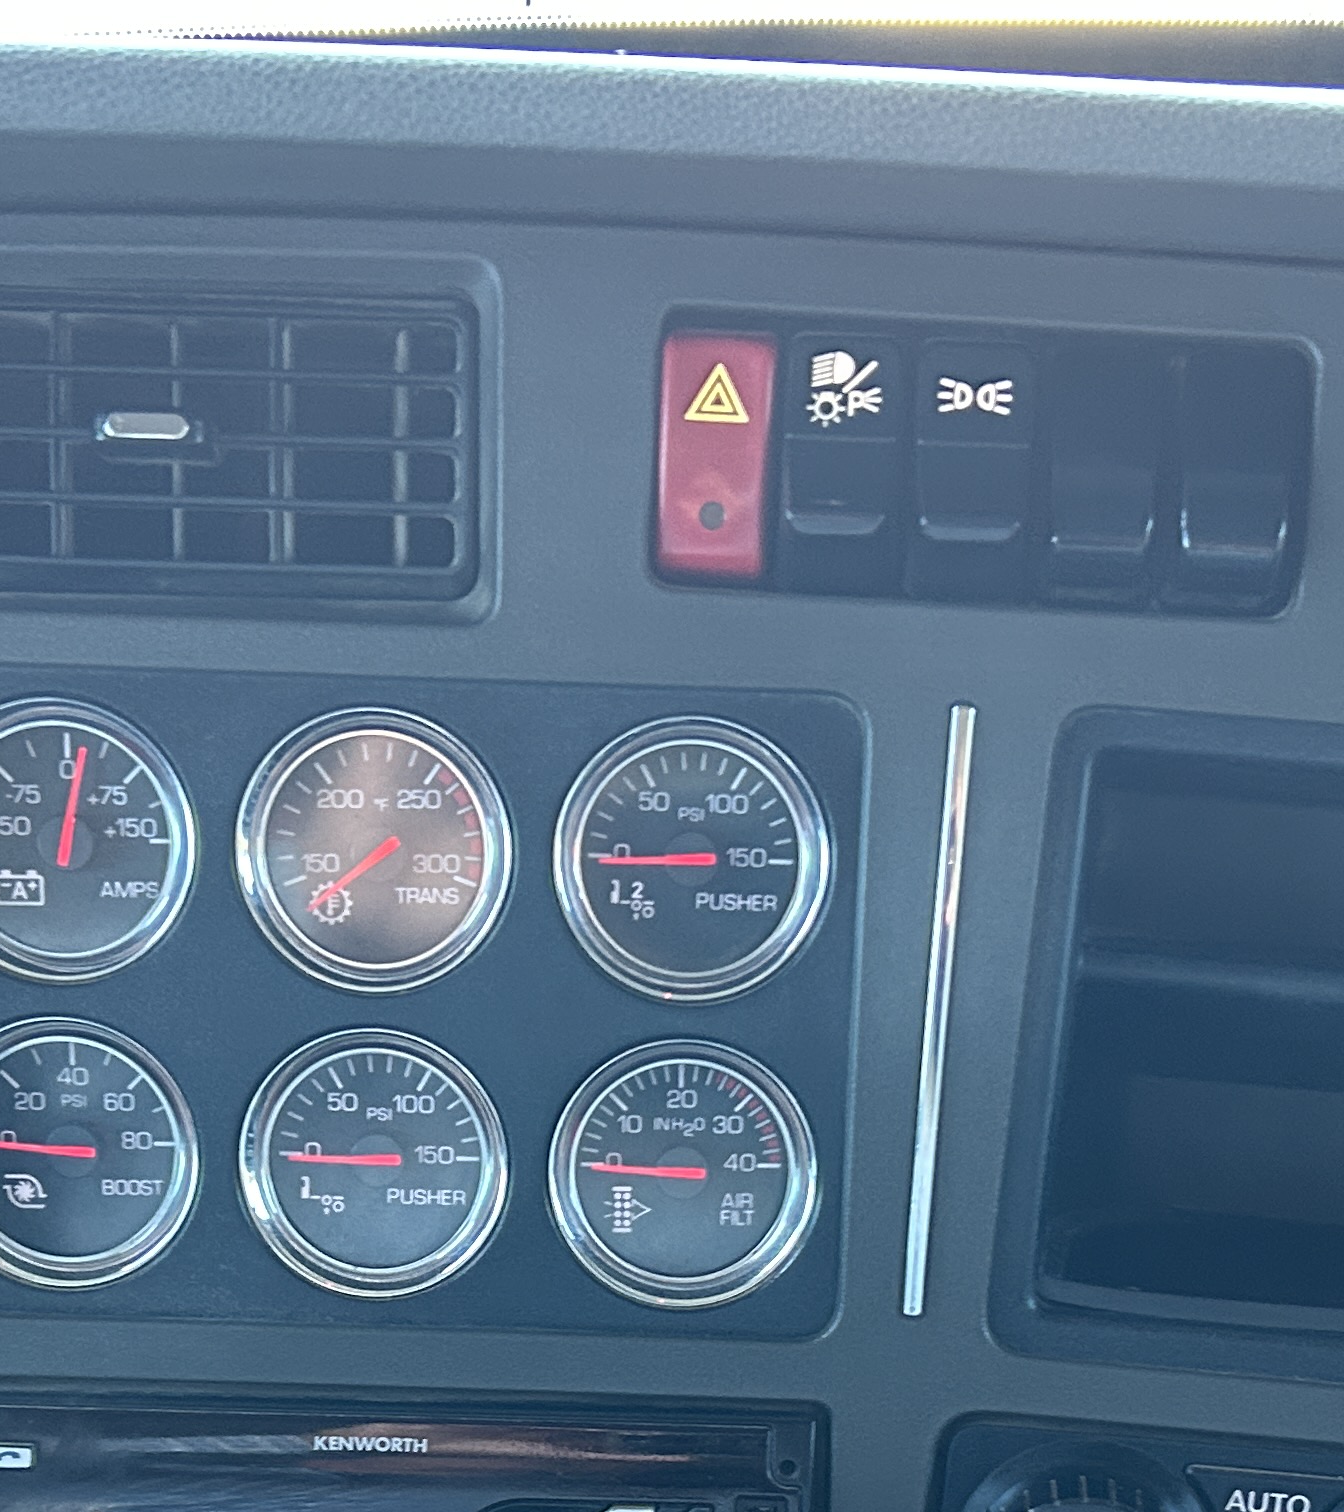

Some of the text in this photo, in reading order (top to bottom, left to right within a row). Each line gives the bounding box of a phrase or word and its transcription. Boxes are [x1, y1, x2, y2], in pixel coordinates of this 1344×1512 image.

[58, 759, 78, 780] 0
[86, 785, 129, 806] +75
[316, 788, 365, 810] 200
[396, 788, 442, 810] 250
[638, 791, 671, 812] 50
[704, 793, 750, 815] 100
[677, 806, 705, 822] PSI
[104, 817, 157, 839] +150
[301, 852, 341, 873] 150
[412, 853, 461, 875] 300
[726, 847, 767, 868] 150
[99, 880, 160, 899] AMPS
[394, 886, 460, 906] TRANS
[695, 891, 778, 912] PUSHER
[56, 1067, 90, 1086] 40
[14, 1091, 47, 1111] 20
[60, 1093, 88, 1108] PSI
[103, 1092, 136, 1112] 60
[327, 1092, 360, 1112] 50
[391, 1094, 436, 1115] 100
[666, 1089, 698, 1109] 20
[365, 1106, 394, 1121] PSI
[617, 1114, 644, 1135] 10
[711, 1115, 745, 1136] 30
[121, 1131, 154, 1151] 80
[303, 1141, 322, 1156] 0
[413, 1145, 455, 1165] 150
[722, 1152, 757, 1173] 40
[101, 1178, 164, 1197] BOOST
[386, 1186, 467, 1207] PUSHER
[720, 1192, 754, 1209] AIR
[718, 1209, 756, 1227] FILT
[312, 1434, 429, 1454] KENWORTH
